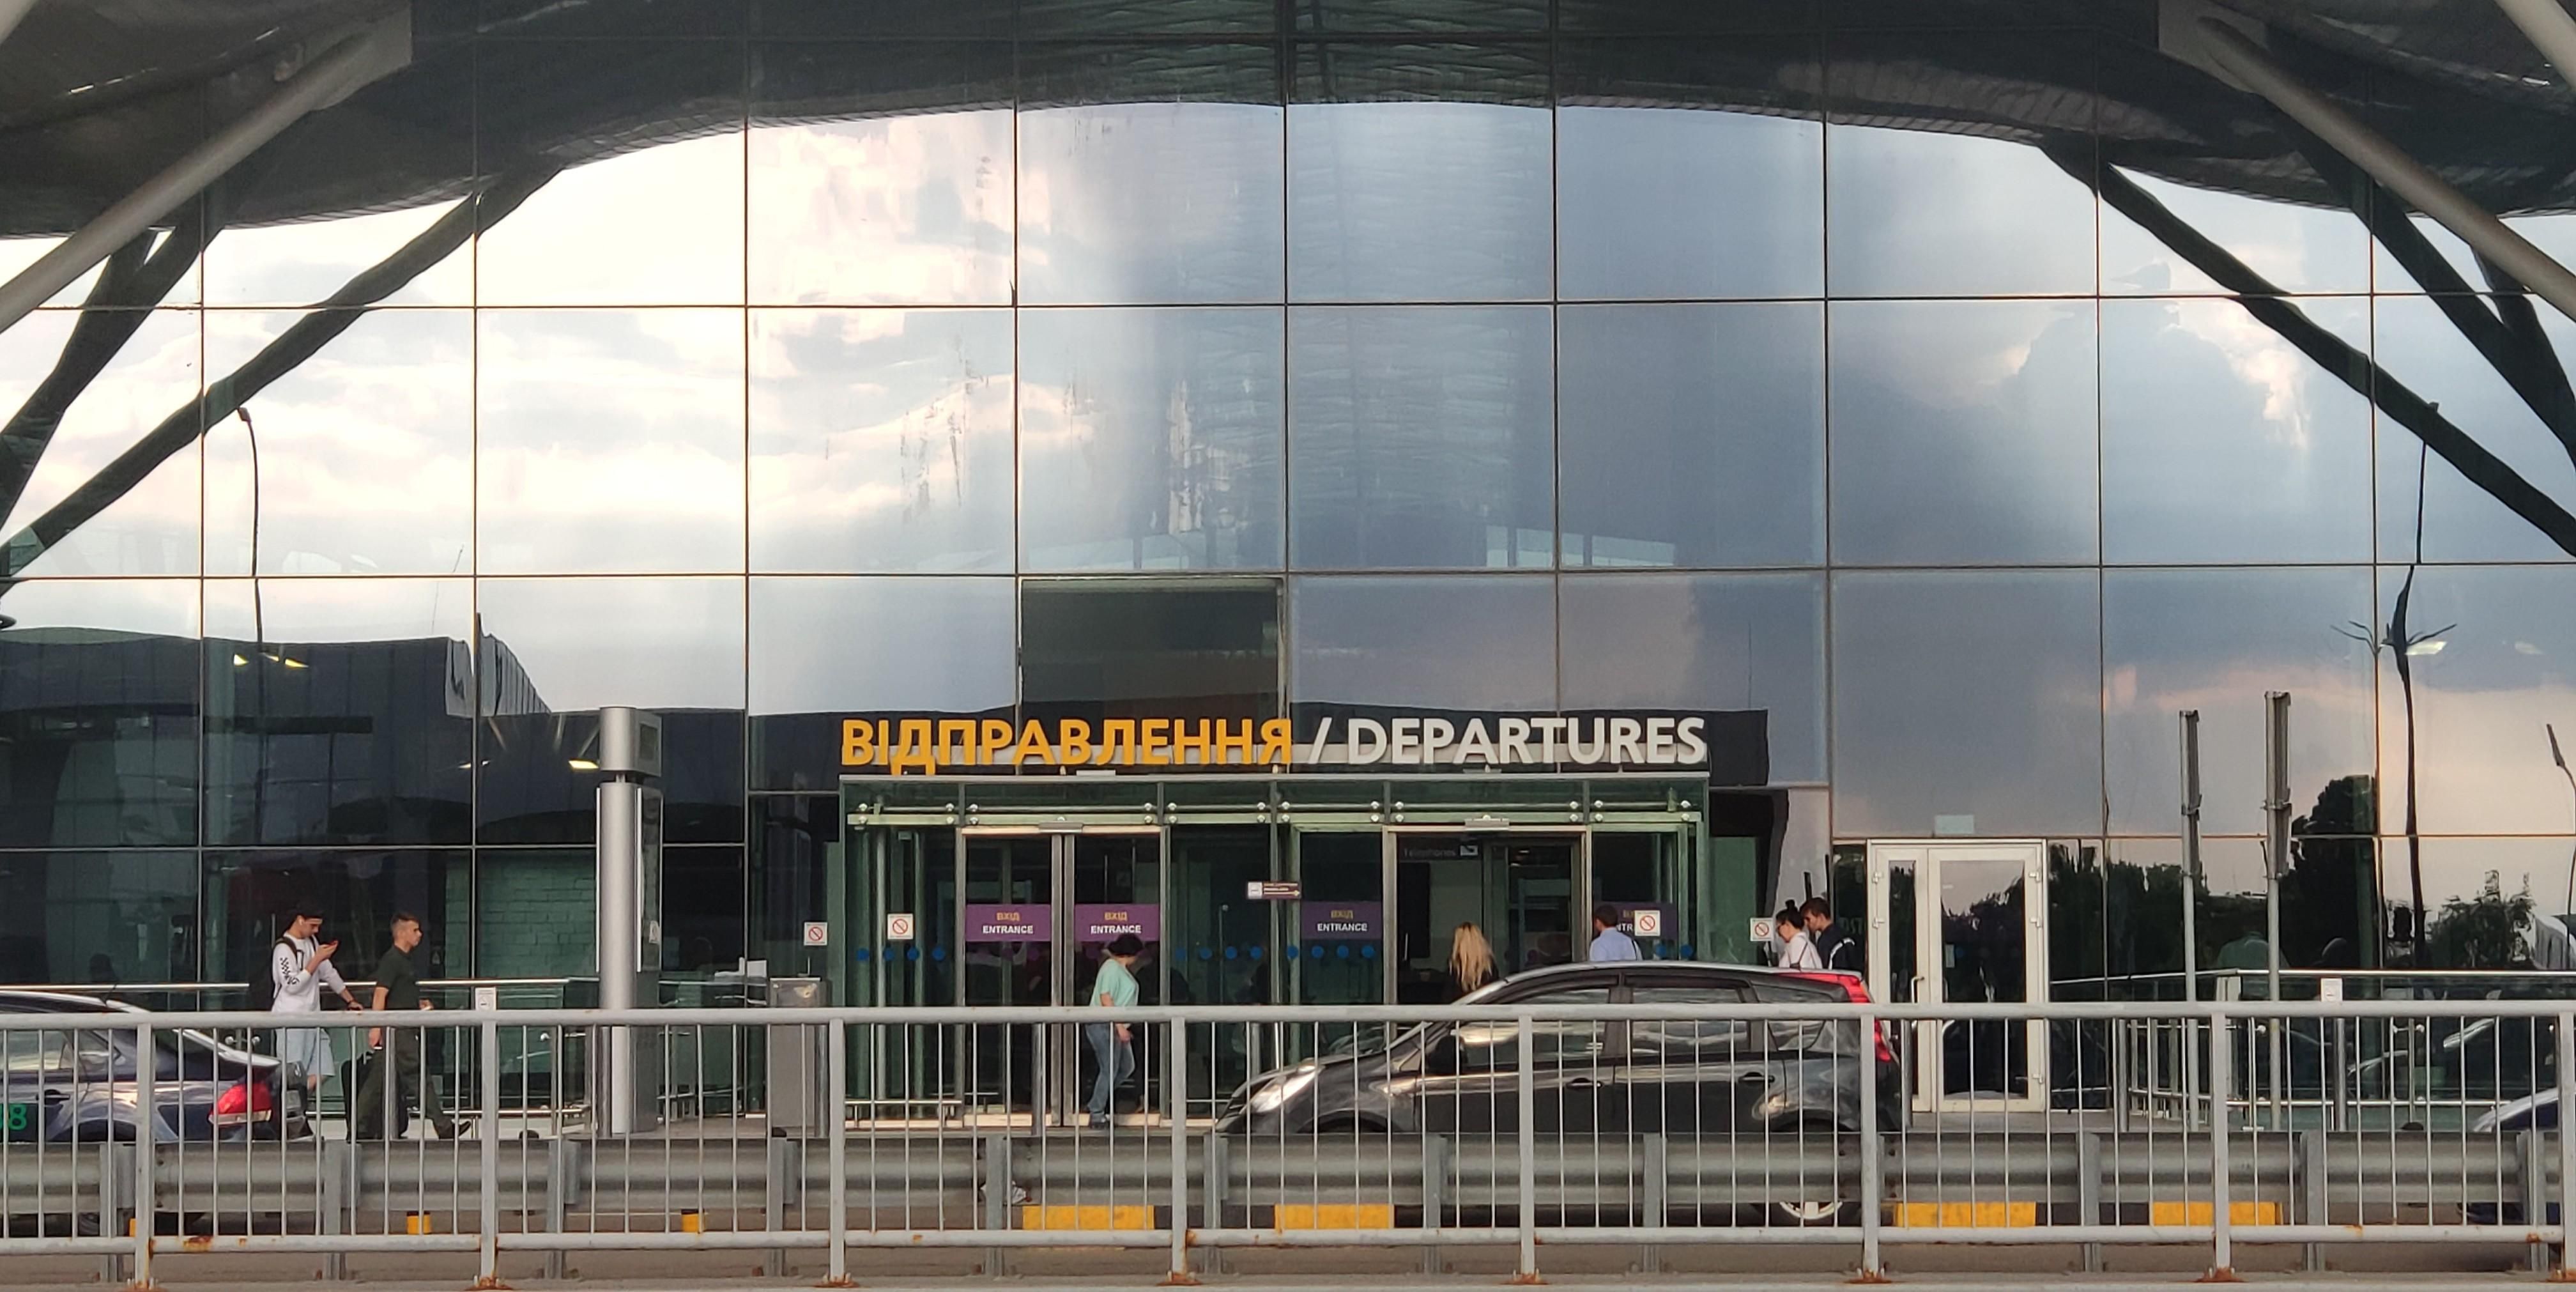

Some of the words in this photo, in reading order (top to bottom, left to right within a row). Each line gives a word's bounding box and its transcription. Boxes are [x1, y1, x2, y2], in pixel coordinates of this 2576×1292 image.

[841, 719, 1292, 775] ВІДПРАВЛЕННЯ
[1308, 717, 1333, 764] /
[1347, 716, 1705, 765] DEPARTURES
[996, 912, 1020, 921] ВХІД
[1104, 911, 1128, 921] ВХІД
[982, 925, 1034, 934] ENTRANCE
[1091, 925, 1142, 934] ENTRANCE
[1317, 923, 1368, 932] ENTRANCE
